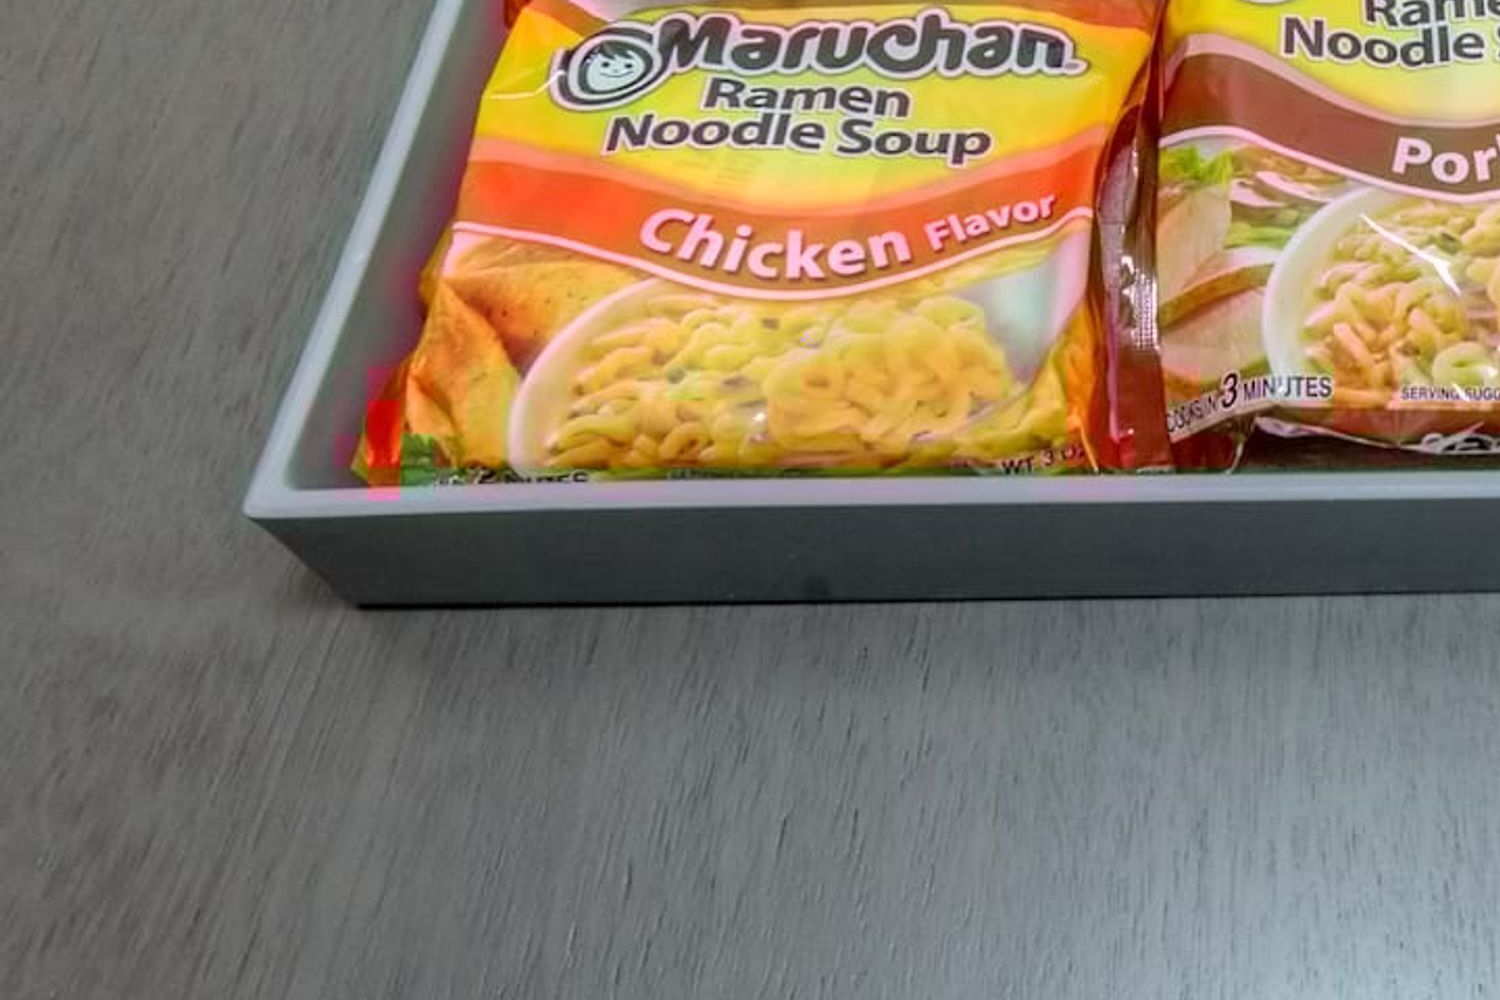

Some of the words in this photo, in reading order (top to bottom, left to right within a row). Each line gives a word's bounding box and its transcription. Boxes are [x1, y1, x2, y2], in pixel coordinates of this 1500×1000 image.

[659, 12, 1067, 74] Maruchan
[1283, 16, 1487, 68] Noodle
[702, 77, 911, 117] Ramen
[605, 113, 826, 153] Noodle
[836, 120, 991, 164] Soup
[640, 208, 912, 280] Chicken
[924, 194, 1058, 251] Flavor
[1221, 372, 1240, 408] 3
